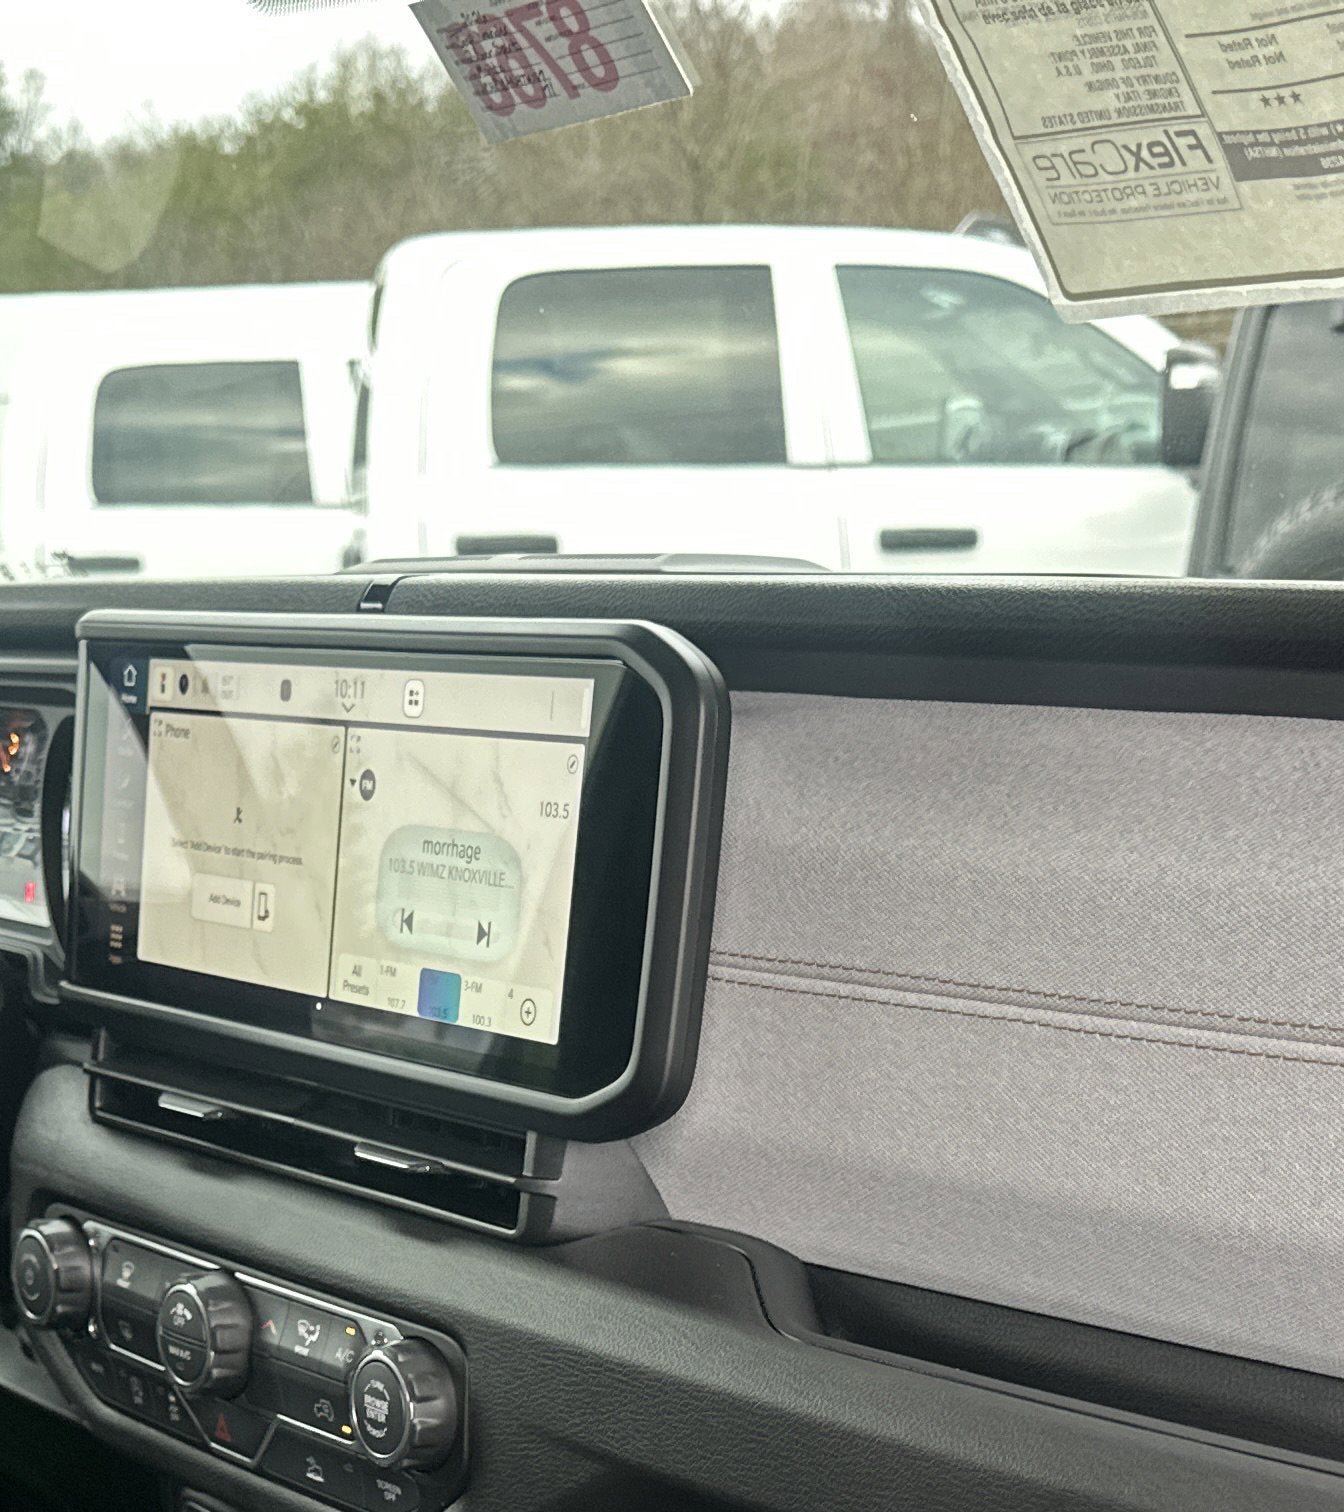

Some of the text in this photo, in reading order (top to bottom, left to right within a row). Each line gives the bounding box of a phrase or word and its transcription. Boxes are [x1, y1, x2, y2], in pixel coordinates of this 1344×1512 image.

[333, 678, 365, 699] 10:11
[361, 779, 374, 791] FM
[538, 801, 570, 820] 103.5
[422, 839, 481, 864] morrhage
[389, 858, 415, 875] 103.5
[416, 861, 446, 879] WIMZ
